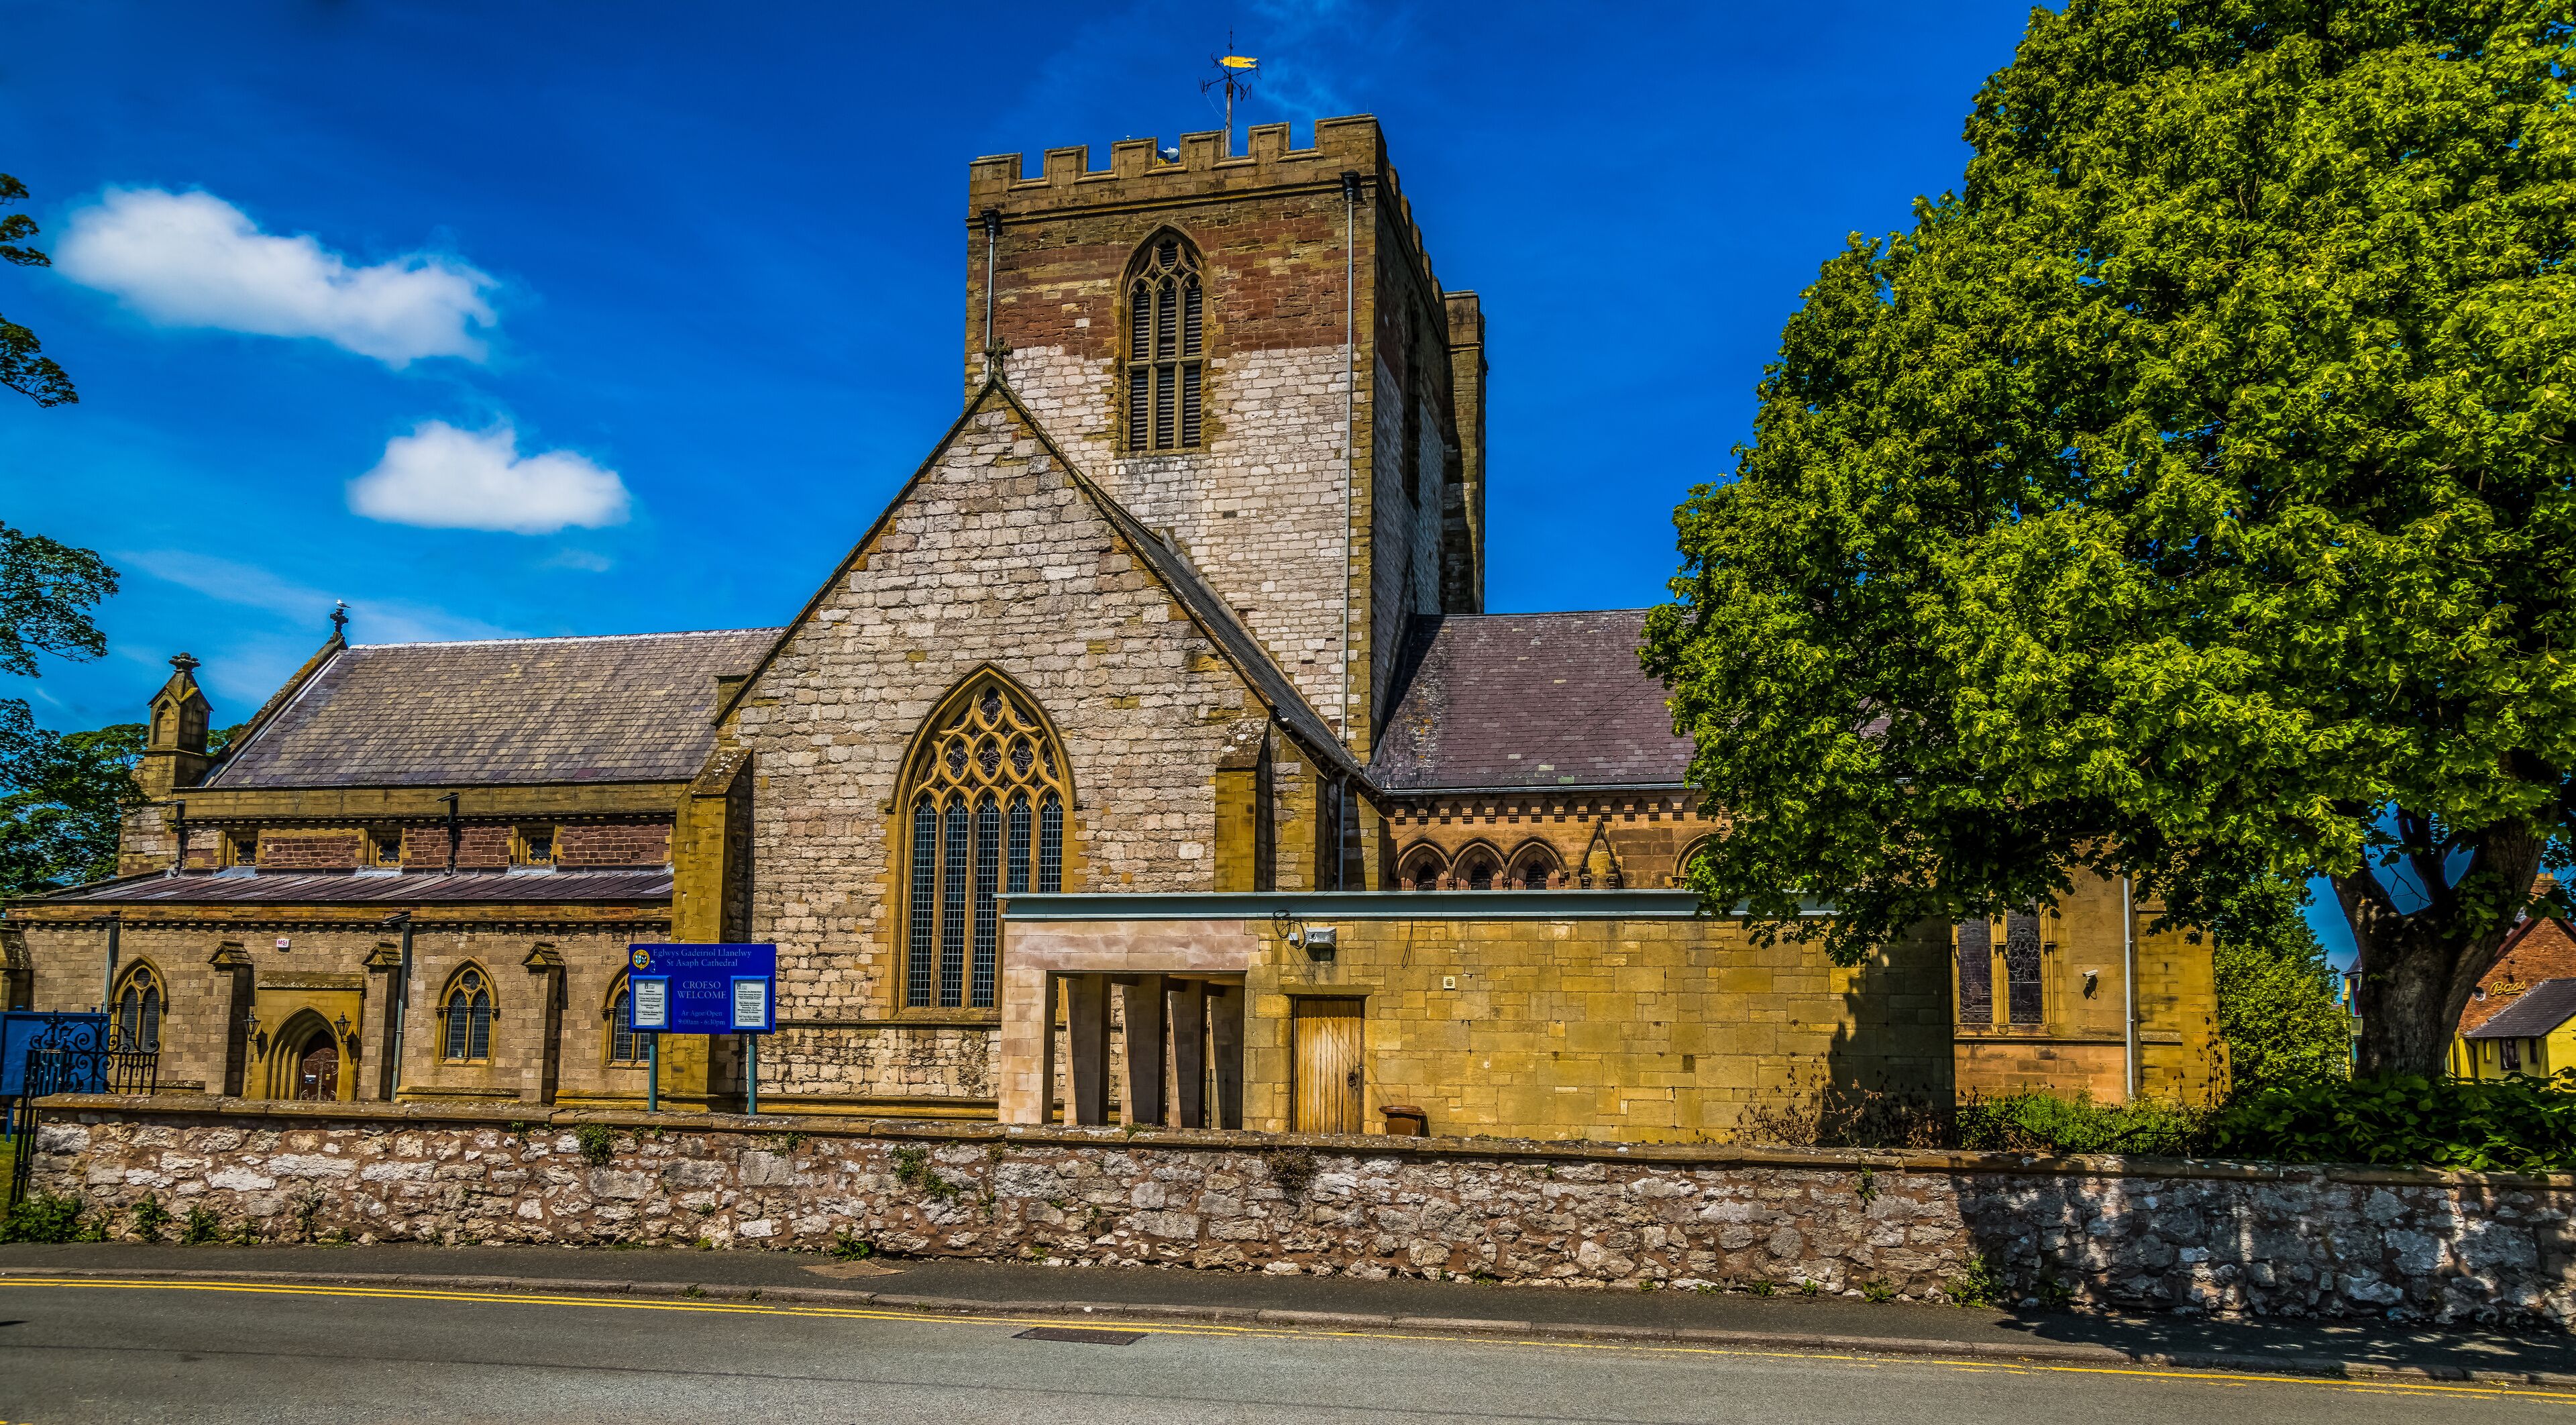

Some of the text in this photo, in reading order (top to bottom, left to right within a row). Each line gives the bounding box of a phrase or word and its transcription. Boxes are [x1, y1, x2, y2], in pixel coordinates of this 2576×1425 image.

[653, 948, 751, 958] Eglwys Gadeiriol Llanelwy
[676, 959, 698, 968] Asaph
[701, 959, 738, 967] Cathedral
[682, 981, 721, 989] CROESO
[2489, 980, 2526, 996] Bass
[677, 990, 727, 999] WELCOME
[704, 1018, 725, 1026] 6:30pm
